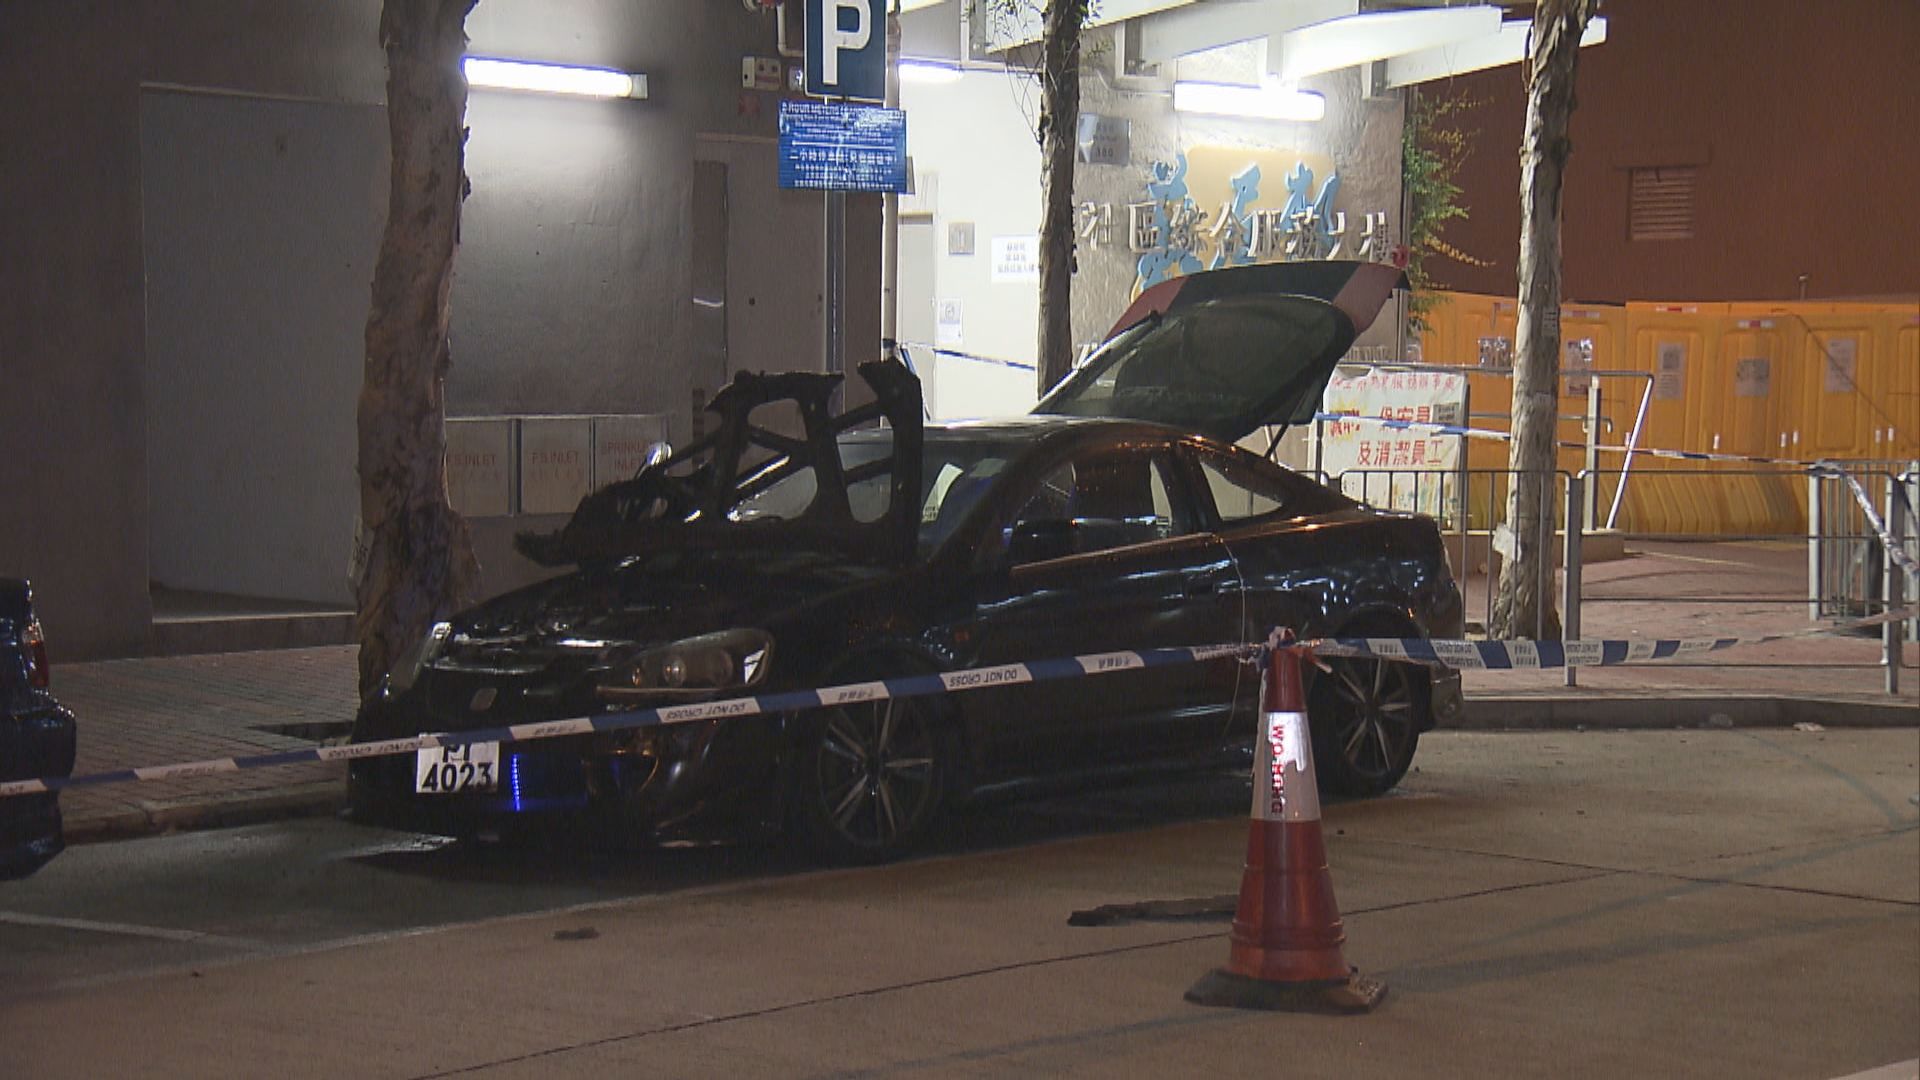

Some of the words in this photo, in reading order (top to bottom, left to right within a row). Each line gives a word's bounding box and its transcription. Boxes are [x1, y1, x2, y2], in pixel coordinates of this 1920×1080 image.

[823, 0, 871, 86] P
[1357, 439, 1444, 467] 及清潔員工
[949, 672, 982, 688] CROSS
[983, 670, 1003, 683] NOT
[1005, 668, 1018, 681] DO
[665, 707, 704, 721] CROSS
[706, 704, 730, 717] NOT
[421, 762, 494, 792] 4023
